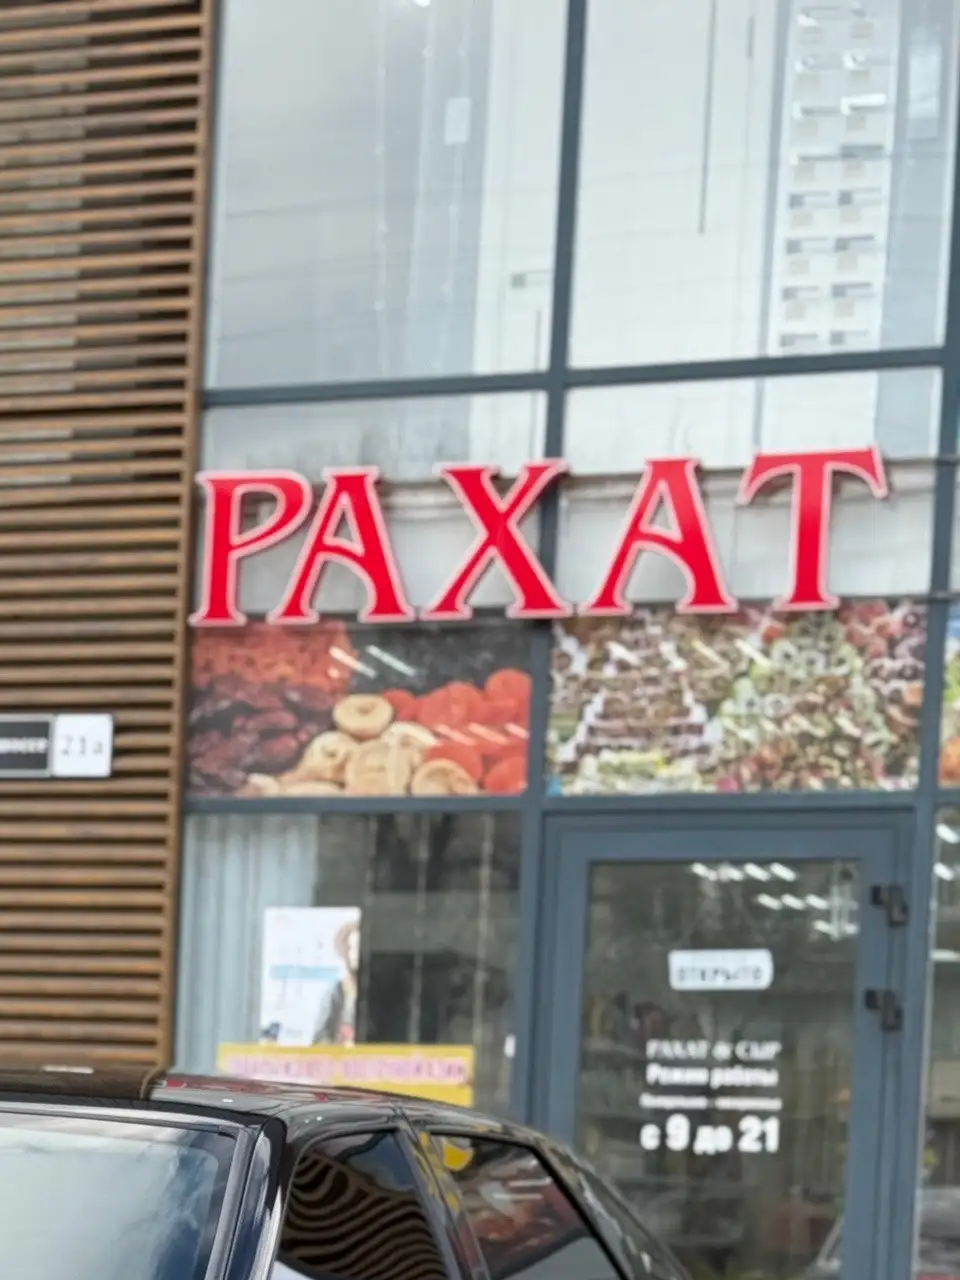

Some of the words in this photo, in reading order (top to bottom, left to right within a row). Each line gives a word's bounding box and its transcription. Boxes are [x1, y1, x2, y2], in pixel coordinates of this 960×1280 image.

[189, 446, 888, 627] РАХАТ
[665, 1113, 690, 1152] 9
[693, 1124, 734, 1155] до
[738, 1114, 780, 1154] 21
